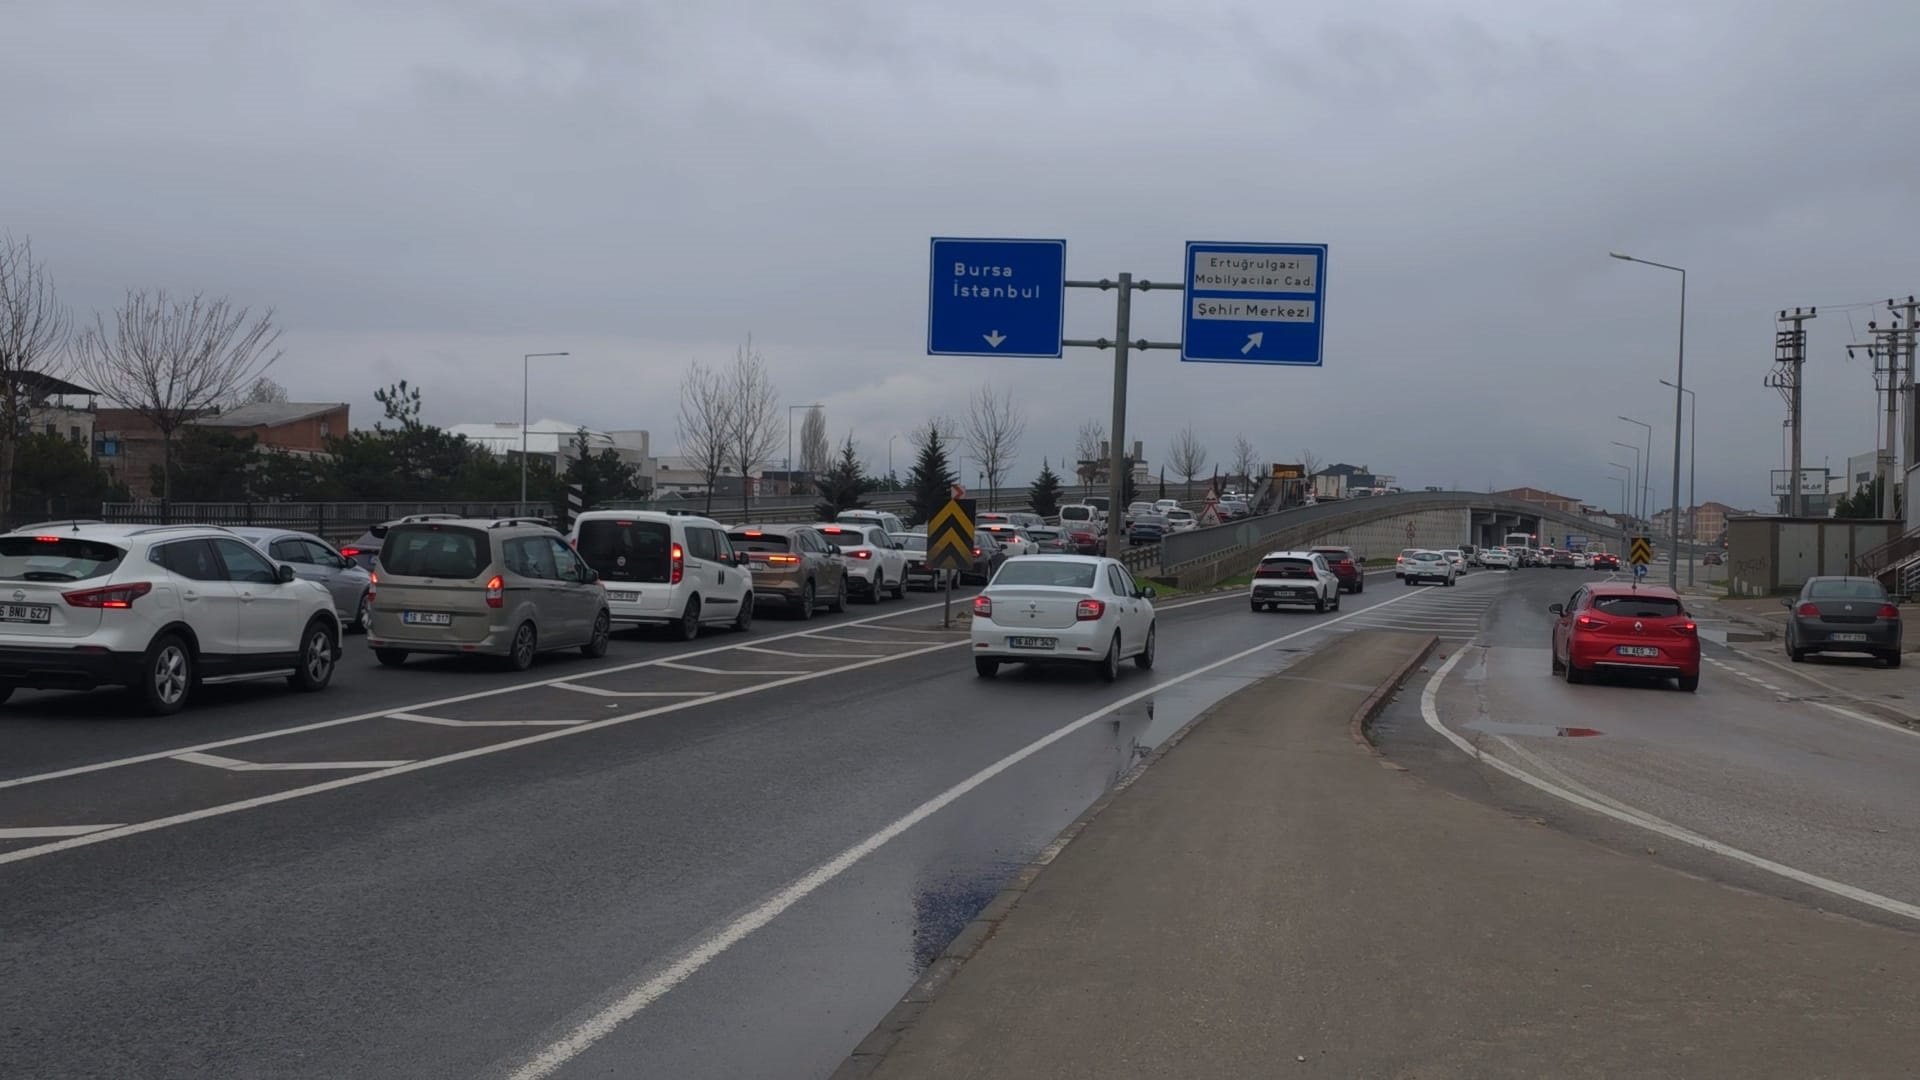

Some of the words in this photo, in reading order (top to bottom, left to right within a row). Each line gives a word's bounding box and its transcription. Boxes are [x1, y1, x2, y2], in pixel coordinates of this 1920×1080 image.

[954, 262, 1012, 277] Bursa
[1210, 257, 1300, 272] Ertuğrulgazi
[1195, 274, 1279, 287] Mobilyacılar
[1285, 276, 1314, 287] Cad.
[953, 280, 1040, 299] İstanbul
[1198, 303, 1240, 317] Şehir
[1246, 304, 1310, 318] Merkezi
[9, 606, 26, 618] BNU
[31, 607, 48, 619] 627
